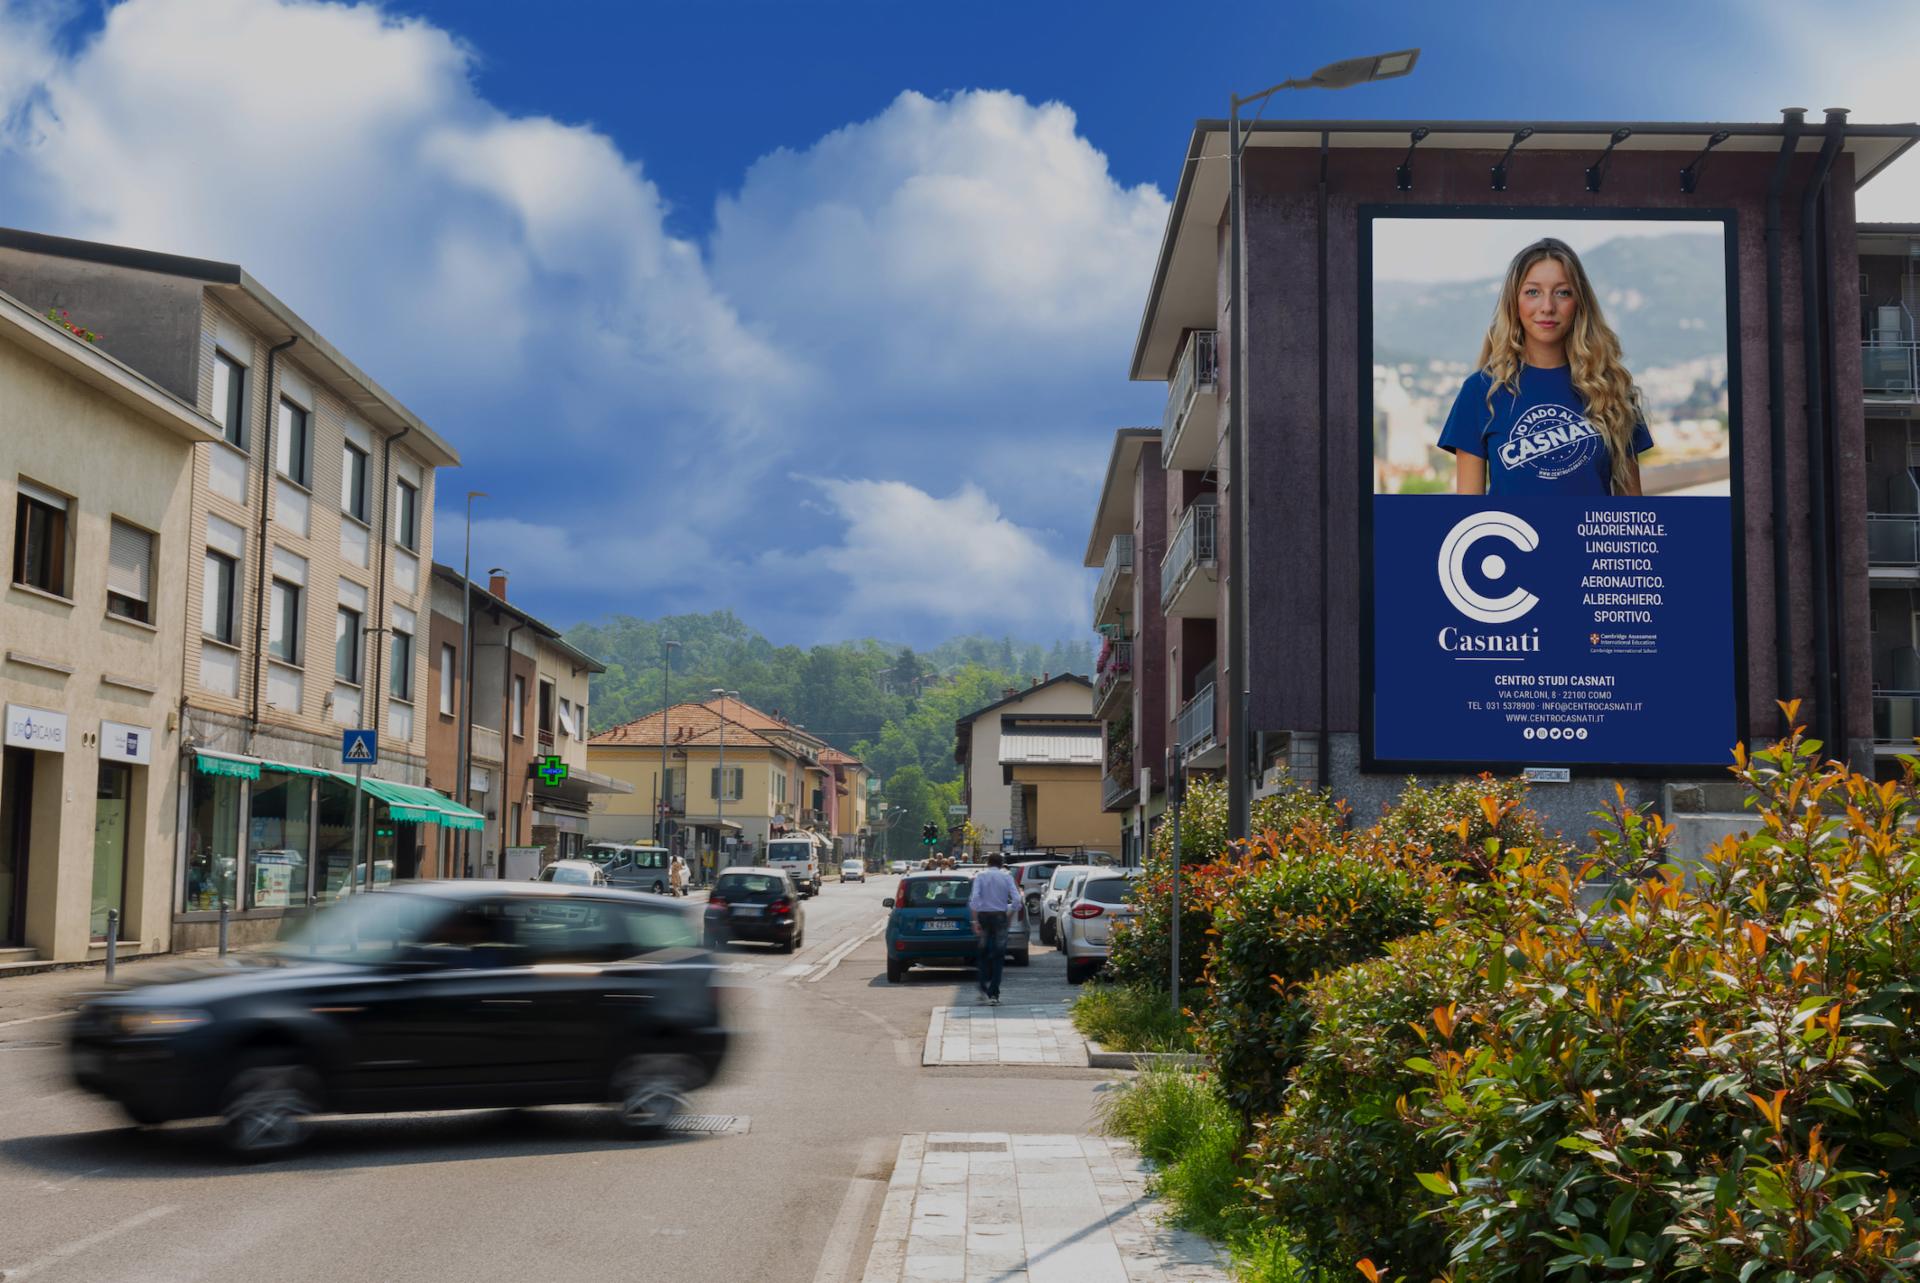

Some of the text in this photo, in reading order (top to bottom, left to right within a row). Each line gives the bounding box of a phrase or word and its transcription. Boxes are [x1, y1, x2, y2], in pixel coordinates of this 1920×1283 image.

[1515, 408, 1574, 437] IO VADO AL
[1501, 420, 1596, 465] CASNAT
[1586, 511, 1657, 524] LINGUISTICO
[1577, 524, 1668, 538] QUADRIENNALE.
[1586, 541, 1660, 554] LINGUISTICO.
[1592, 559, 1653, 571] ARTISTICO.
[1581, 576, 1665, 588] AERONAUTICO.
[1582, 593, 1664, 606] ALBERGHIERO.
[1594, 611, 1653, 623] SPORTIVO.
[1438, 626, 1541, 652] Casnati
[1494, 675, 1615, 687] CENTRO STUDI CASNATI
[1498, 690, 1512, 699] VIA
[1513, 690, 1550, 700] CARLONI,
[1562, 691, 1587, 700] 22100
[1588, 691, 1612, 700] COMO
[1486, 702, 1500, 710] 031
[1502, 702, 1536, 711] 5378900
[1542, 702, 1643, 712] INFO@CENTROCASNATI.IT
[1505, 714, 1605, 723] WWW.CENTROCASNATI.IT
